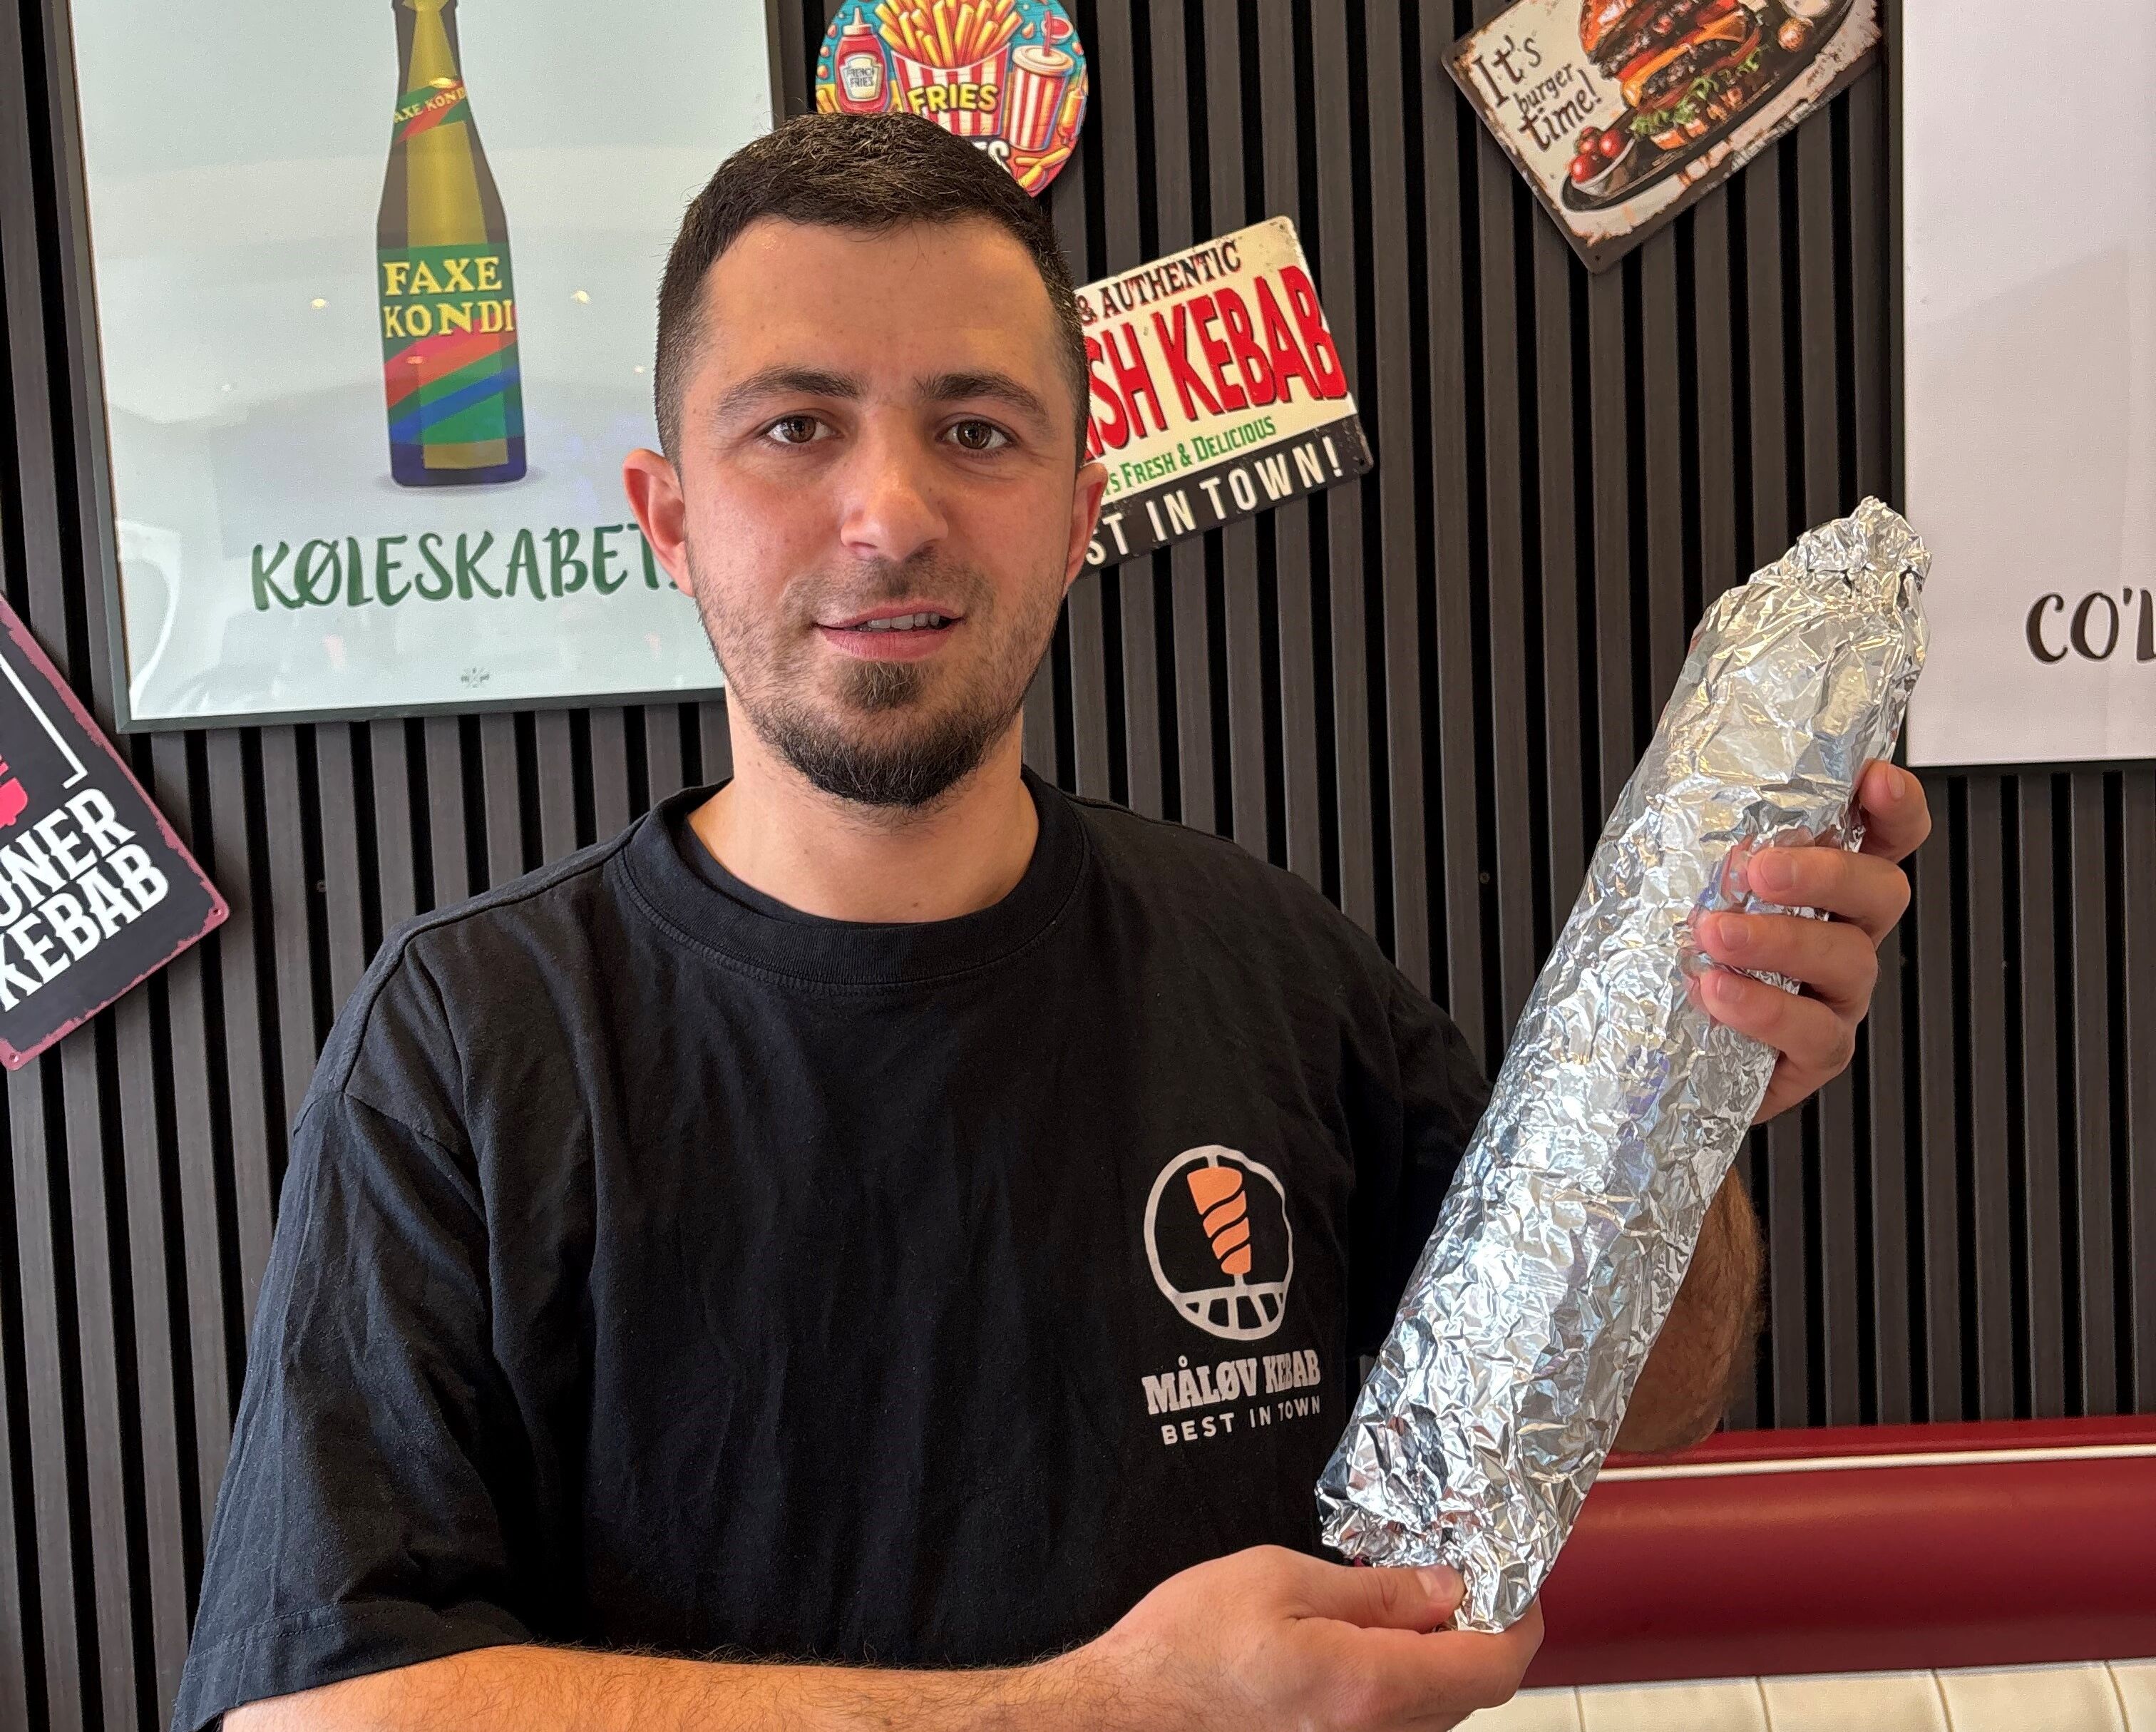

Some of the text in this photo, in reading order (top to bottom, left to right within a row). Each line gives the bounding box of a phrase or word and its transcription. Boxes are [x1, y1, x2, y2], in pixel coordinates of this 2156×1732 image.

[907, 82, 998, 114] FRIES
[1472, 35, 1541, 107] It's
[1512, 63, 1574, 114] burger
[1518, 69, 1602, 151] time!
[383, 256, 503, 297] FAXE
[1075, 240, 1241, 327] & AUTHENTIC
[383, 299, 516, 339] KONDI
[1083, 265, 1349, 462] SH KEBAB
[1177, 442, 1192, 467] &
[1146, 489, 1196, 542] IN
[1199, 436, 1344, 520] TOWN!
[0, 844, 168, 1012] KEBAB
[1141, 1349, 1320, 1415] MÅLØV KEBAB
[1161, 1395, 1320, 1445] BEST IN TOWN
